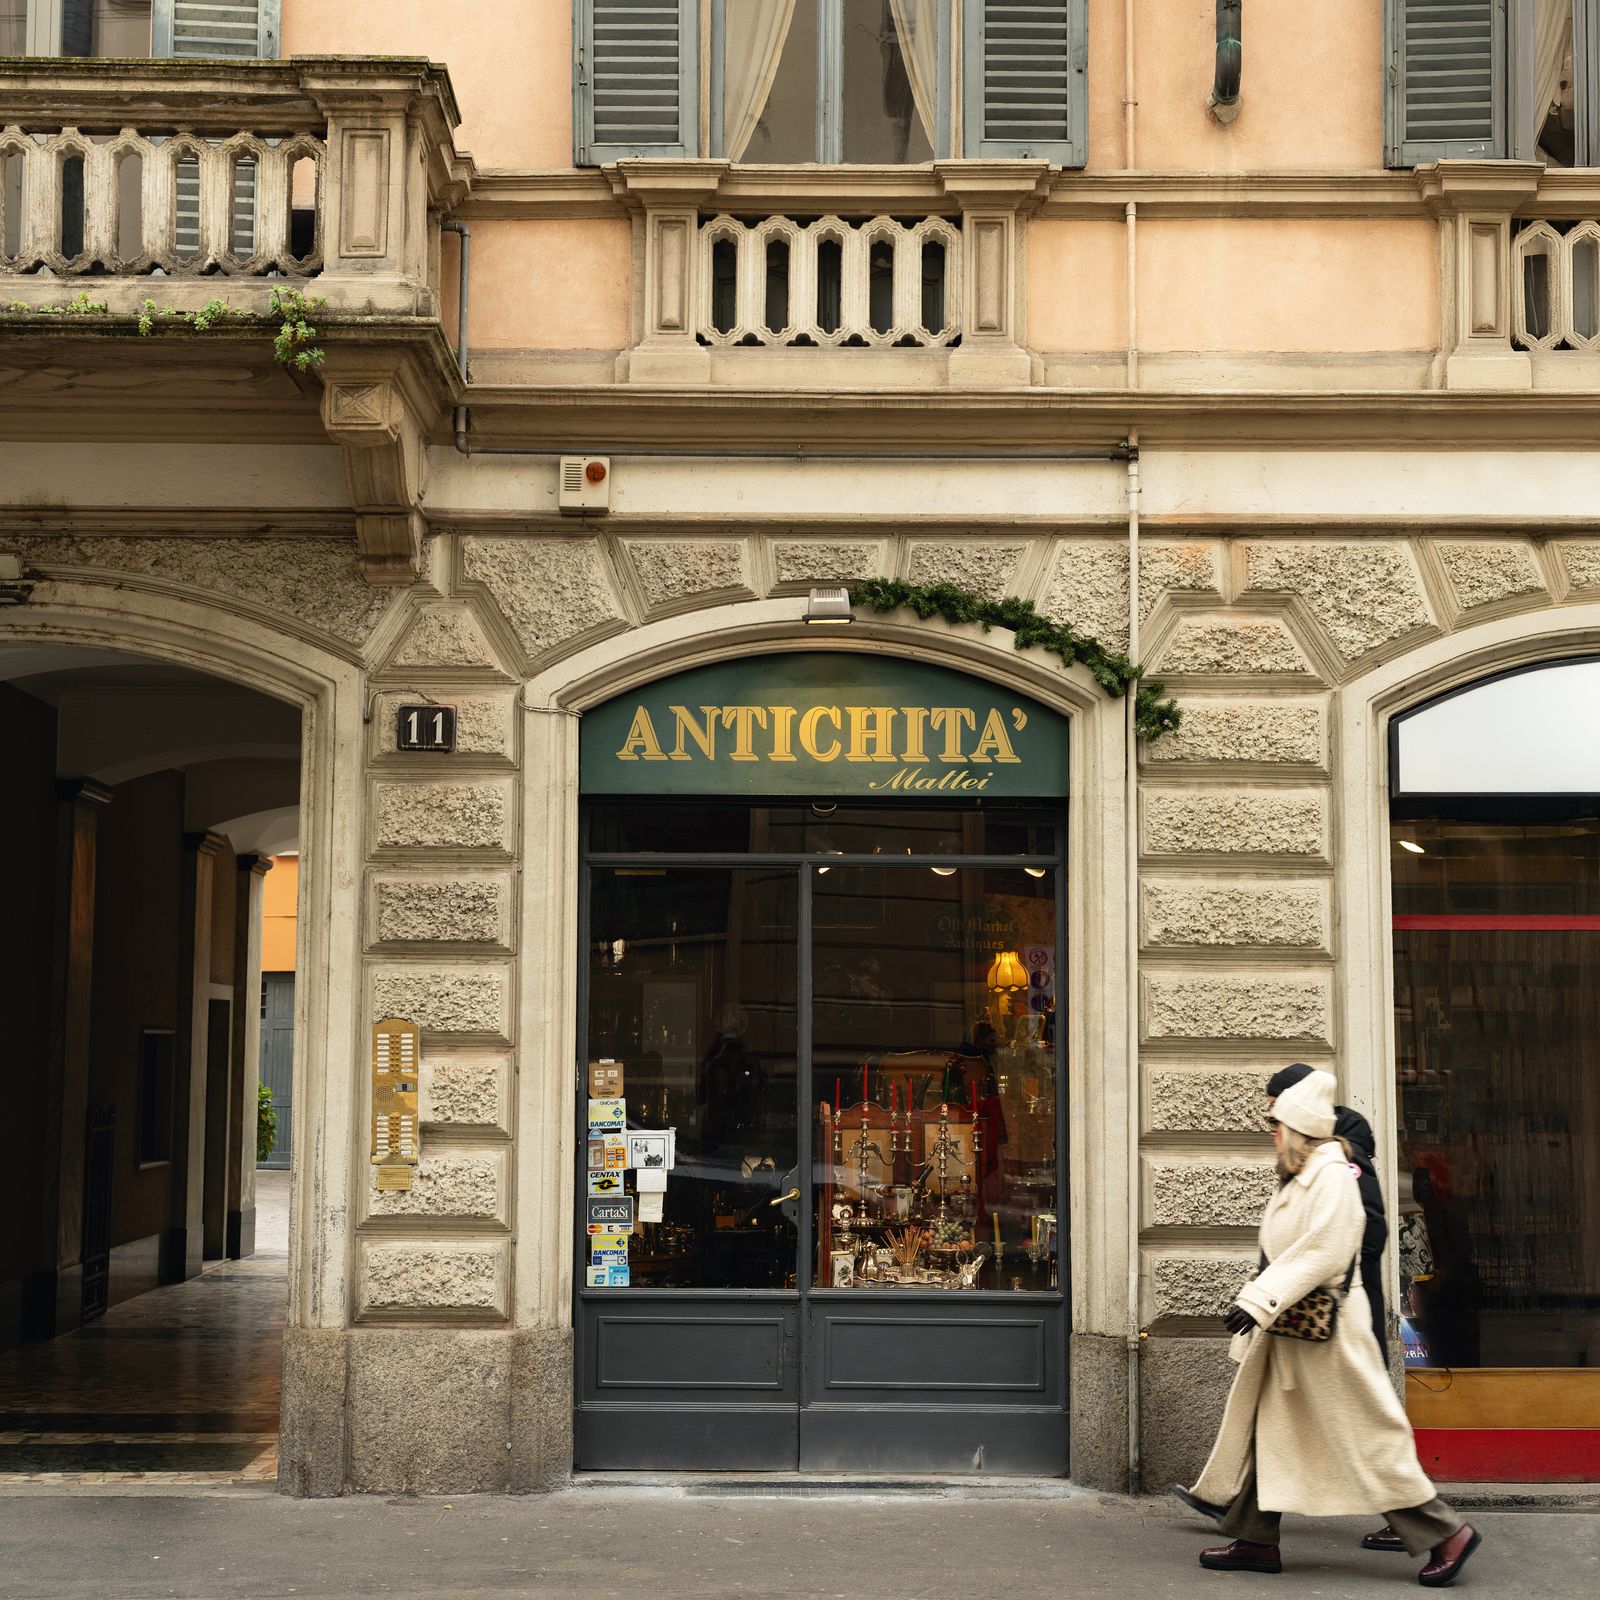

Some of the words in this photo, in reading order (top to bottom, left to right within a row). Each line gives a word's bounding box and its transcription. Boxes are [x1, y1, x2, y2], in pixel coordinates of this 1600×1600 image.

[407, 711, 443, 743] 11
[616, 705, 1027, 763] ANTICHITA'
[868, 767, 993, 791] Mattei
[967, 915, 1015, 933] Market
[944, 934, 1005, 952] Antiques
[590, 1171, 621, 1179] CENTAX
